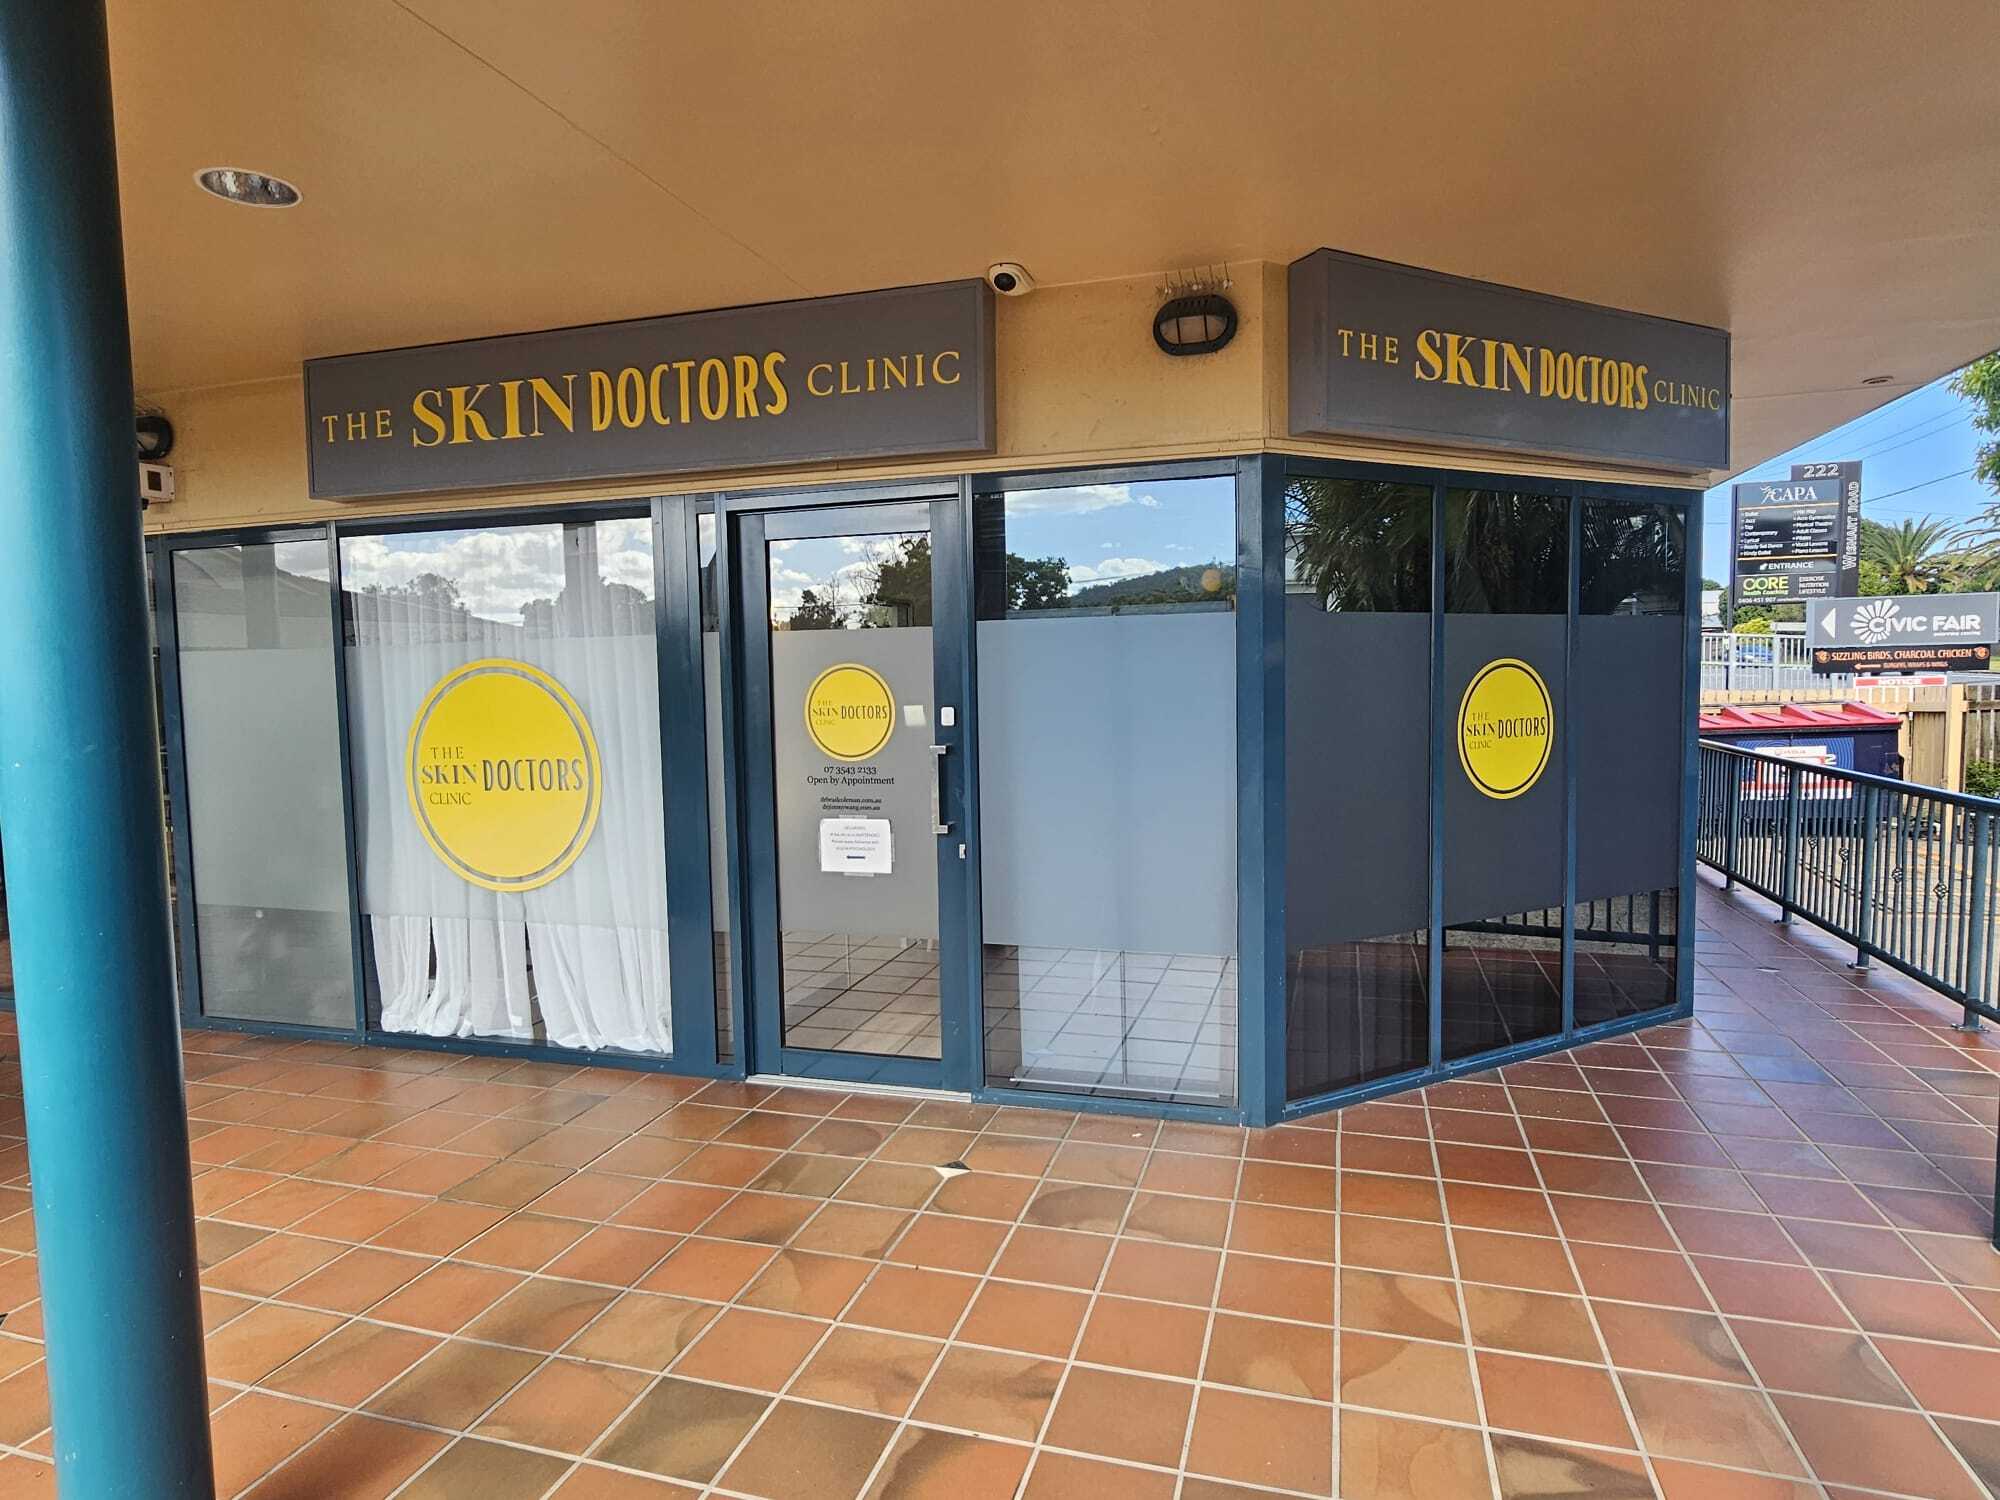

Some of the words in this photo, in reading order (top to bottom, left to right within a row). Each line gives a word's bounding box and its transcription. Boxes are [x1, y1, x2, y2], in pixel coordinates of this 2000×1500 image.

[1338, 329, 1399, 364] THE
[1415, 329, 1534, 395] SKIN
[1539, 347, 1649, 411] DOCTORS
[1653, 379, 1720, 411] CLINIC
[323, 407, 393, 443] THE
[411, 373, 578, 447] SKIN
[590, 351, 788, 432] DOCTORS
[806, 351, 961, 397] CLINIC
[1803, 464, 1840, 479] 222
[1771, 486, 1818, 502] CAPA
[1768, 561, 1815, 570] ENTRANCE
[1743, 575, 1789, 591] CORE
[1868, 615, 1927, 633] CIVIC
[1932, 614, 1981, 632] FAIR
[1831, 651, 1866, 661] SIZZLING
[1867, 650, 1893, 661] BIRDS,
[1894, 649, 1936, 660] CHARCOAL
[1937, 648, 1972, 659] CHICKEN
[812, 707, 839, 717] SKIN
[841, 705, 888, 720] DOCTORS
[1472, 712, 1490, 721] THE
[1466, 723, 1495, 737] SKIN
[1498, 716, 1546, 740] DOCTORS
[1469, 739, 1492, 750] CLINIC
[430, 746, 464, 760] THE
[421, 764, 477, 785] SKIN
[482, 758, 584, 792] DOCTORS
[823, 766, 834, 774] 07
[835, 766, 856, 775] 3543
[857, 766, 877, 775] 2133
[807, 775, 828, 786] Open
[829, 776, 839, 786] by
[841, 776, 895, 786] Appointment
[429, 792, 472, 806] CLINIC
